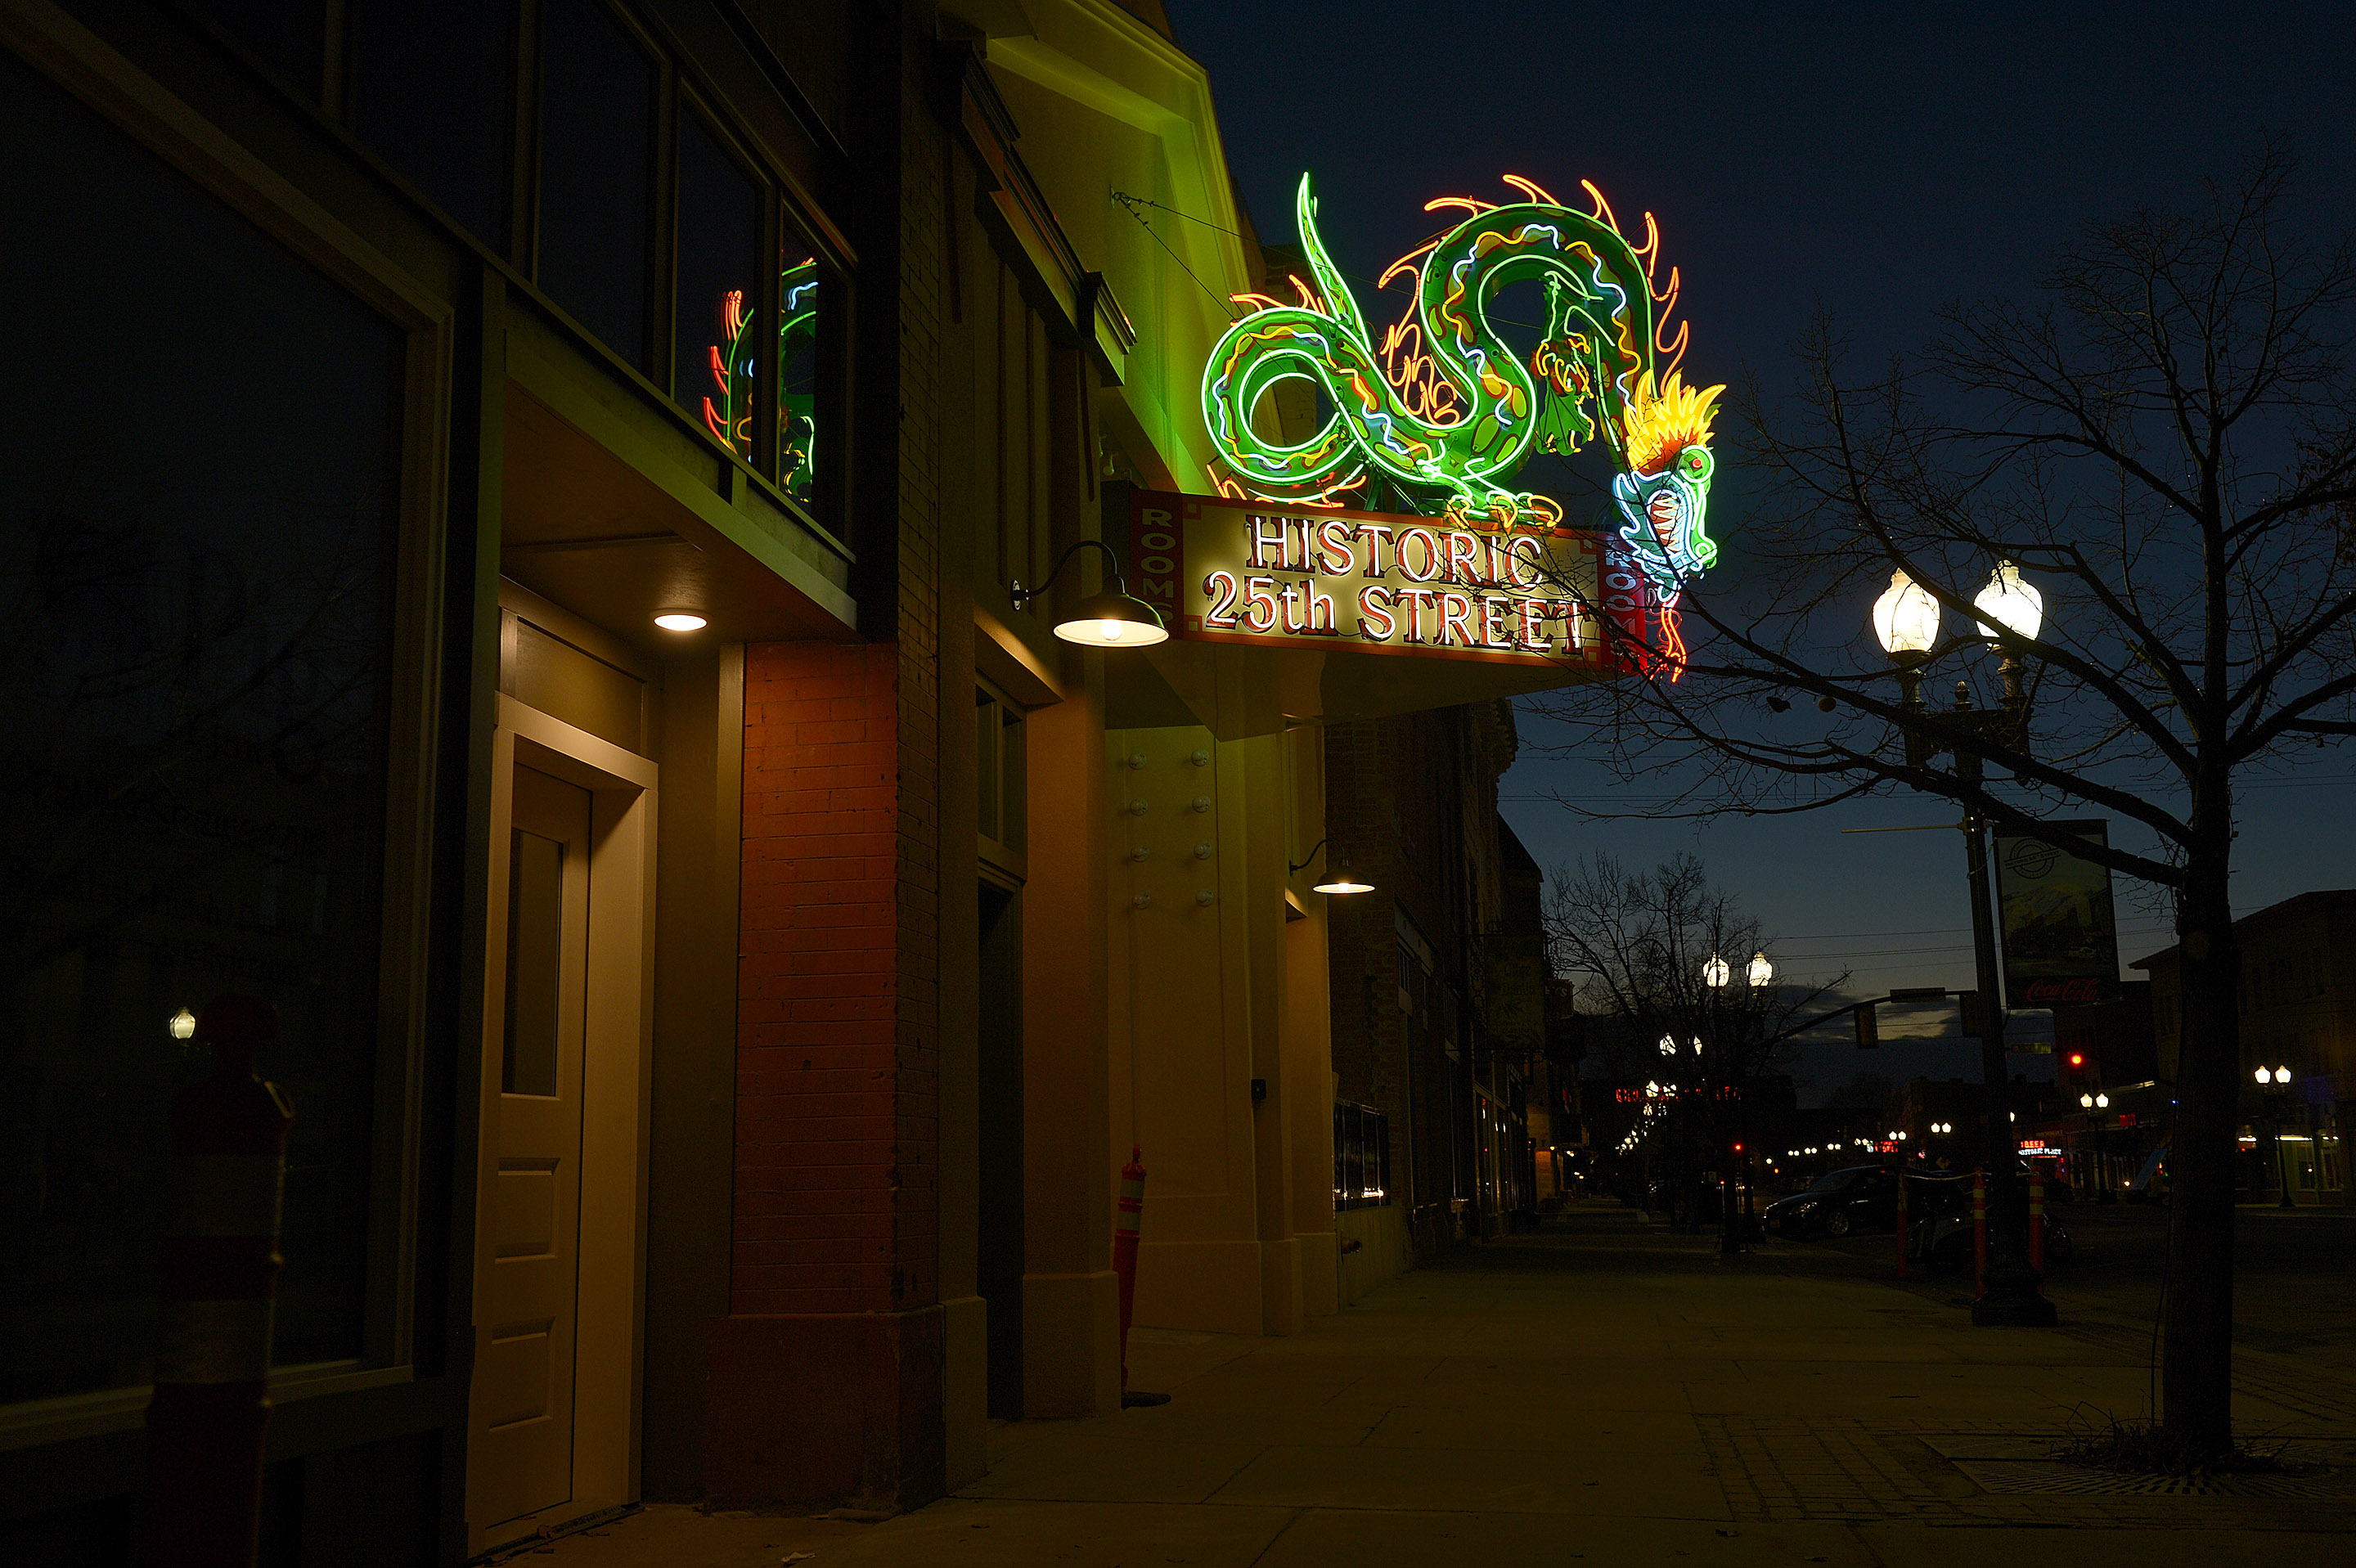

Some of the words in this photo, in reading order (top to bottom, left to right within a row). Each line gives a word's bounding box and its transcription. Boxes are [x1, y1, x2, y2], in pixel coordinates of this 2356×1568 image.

[1140, 508, 1176, 622] ROOMS
[1246, 514, 1544, 591] HISTORIC
[1203, 571, 1338, 636] 25th
[1357, 586, 1590, 654] STREET
